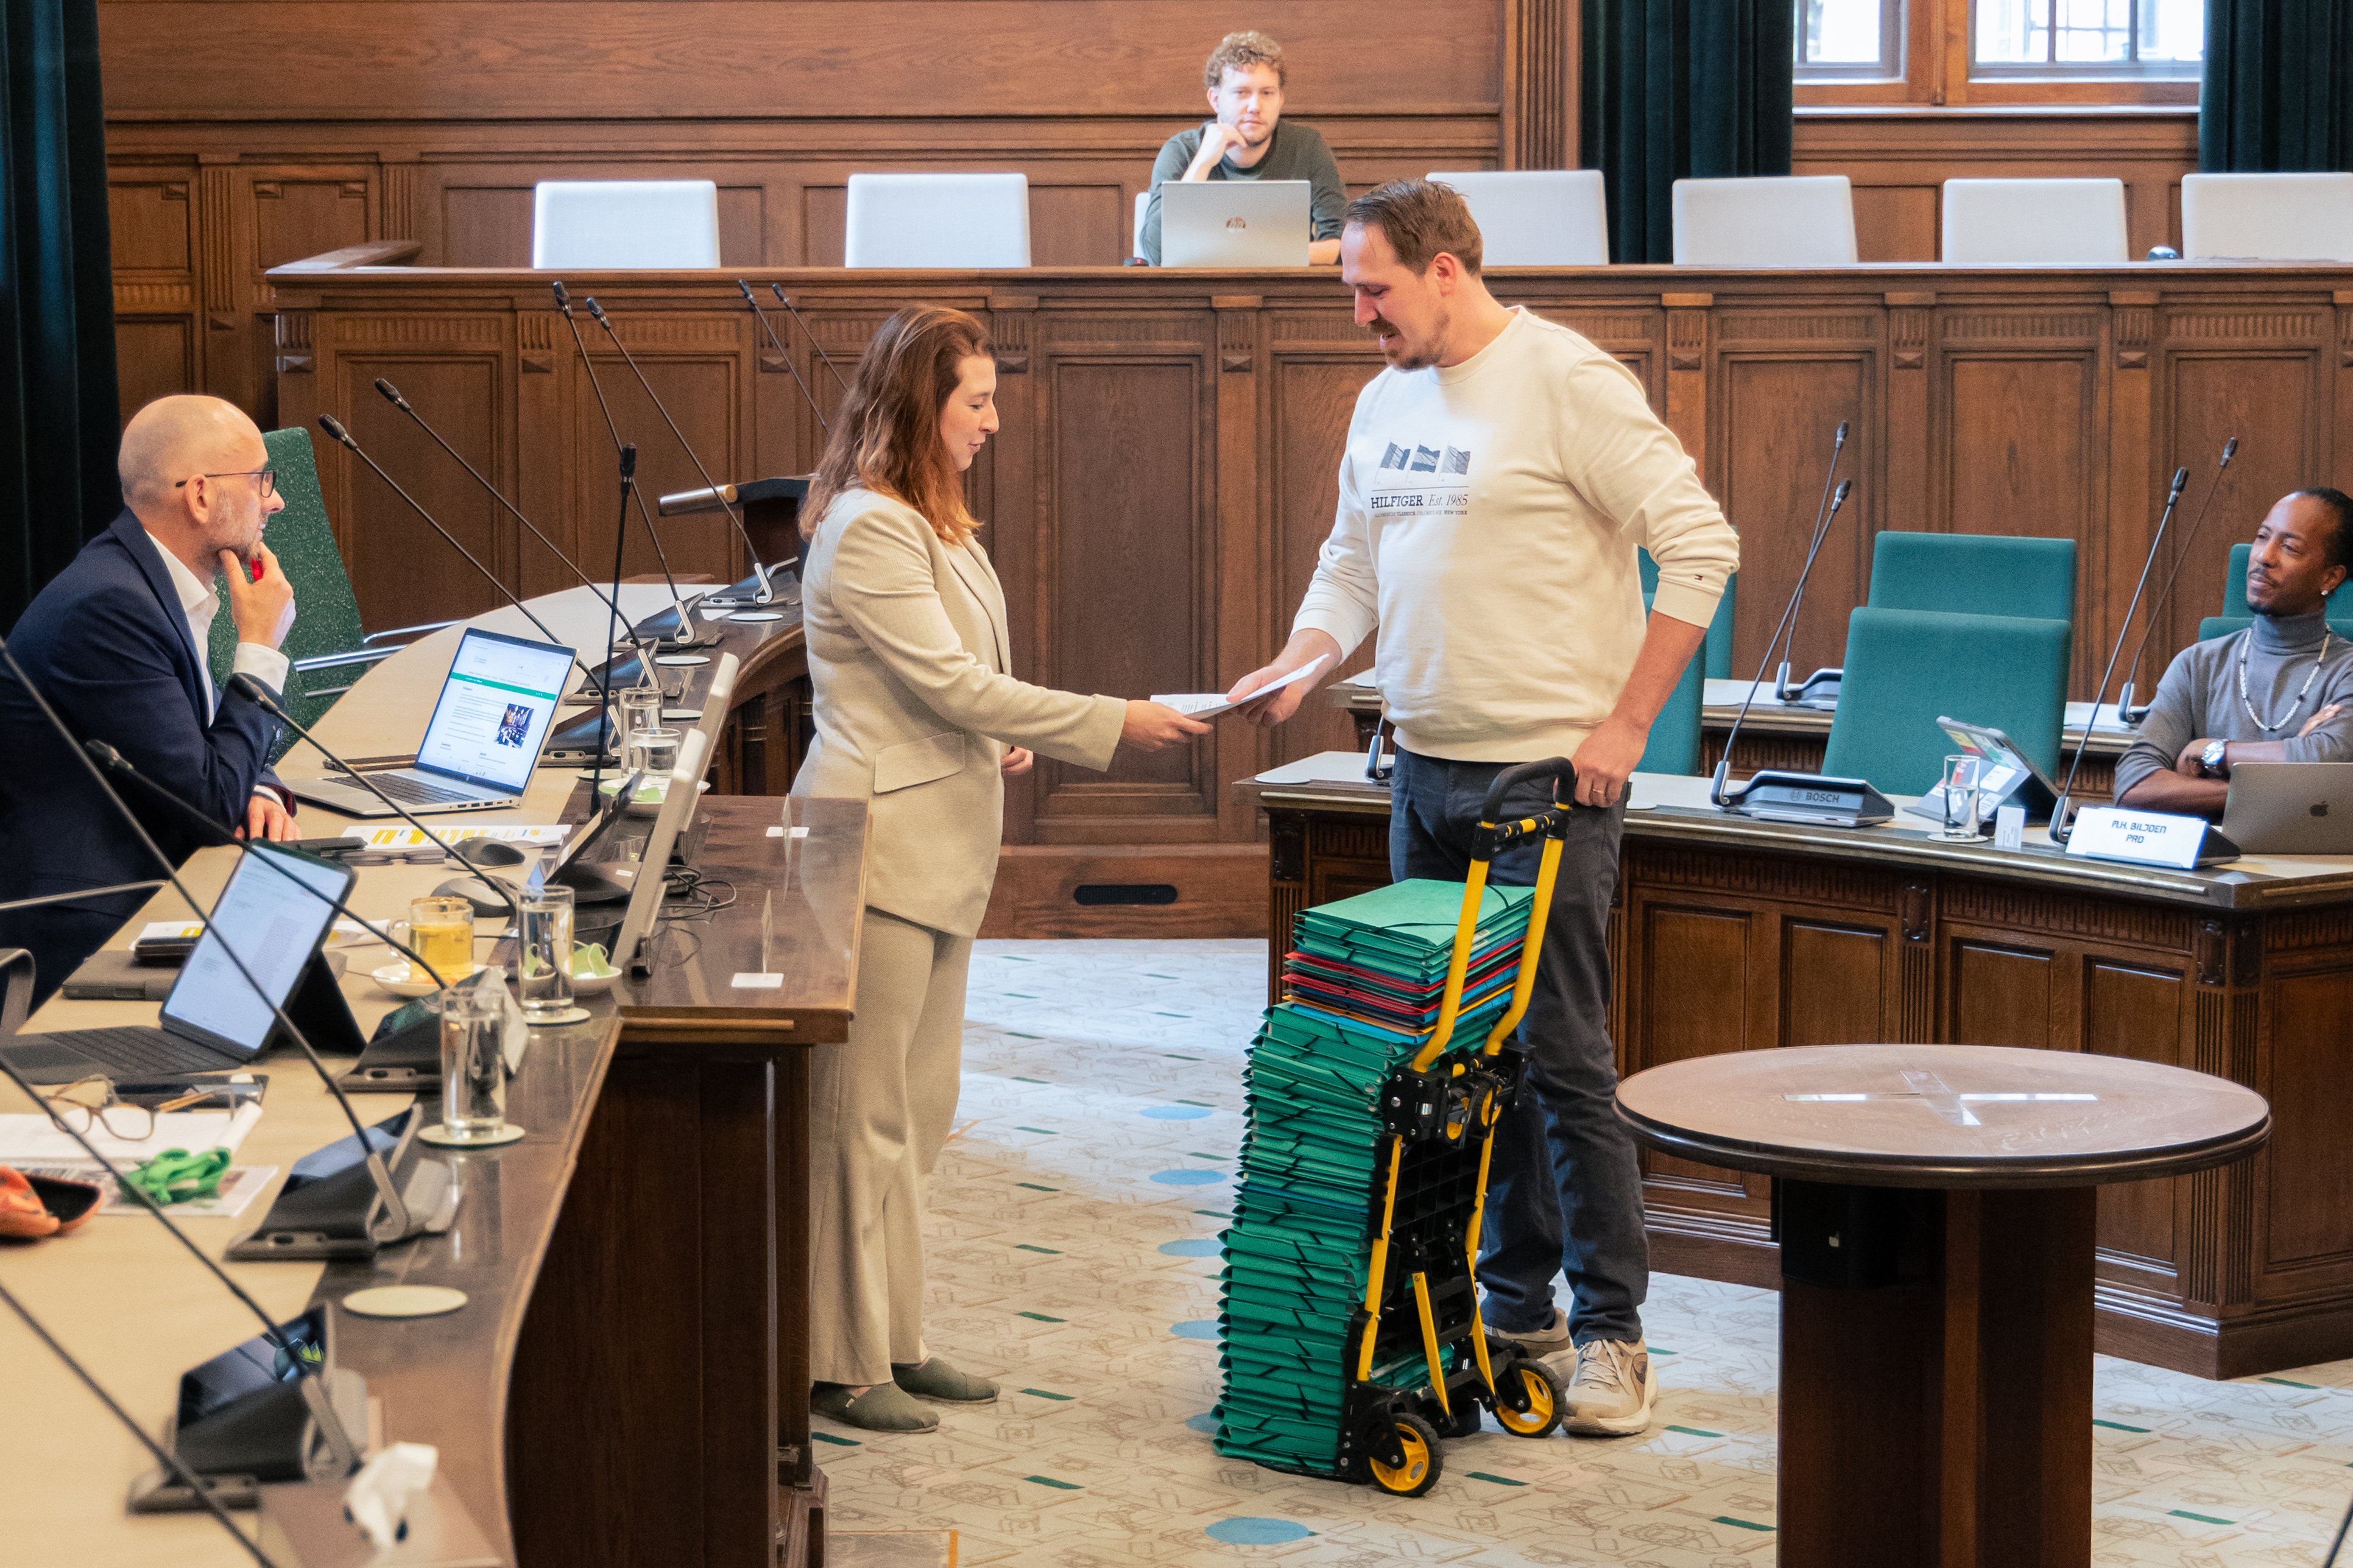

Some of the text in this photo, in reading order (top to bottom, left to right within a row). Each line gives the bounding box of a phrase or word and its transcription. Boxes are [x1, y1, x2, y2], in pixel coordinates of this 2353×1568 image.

[1371, 494, 1469, 508] HILFIGER Est. 1985
[1805, 791, 1840, 803] BOSCH
[2125, 834, 2145, 843] PRO
